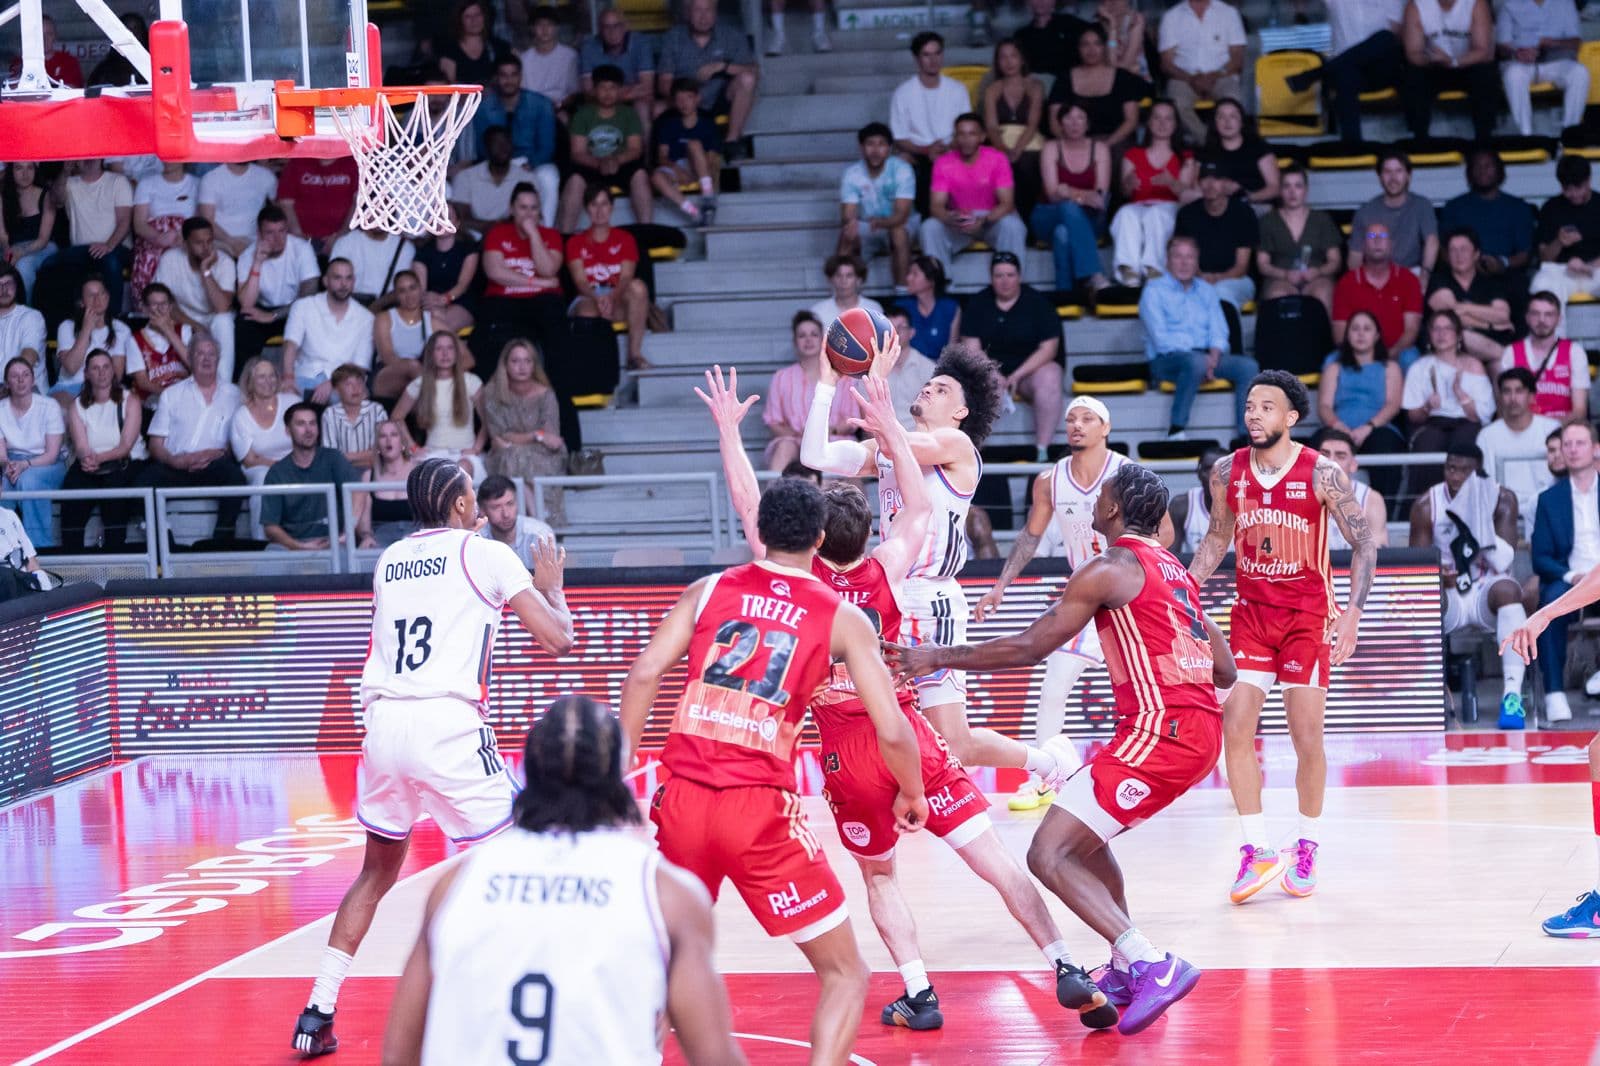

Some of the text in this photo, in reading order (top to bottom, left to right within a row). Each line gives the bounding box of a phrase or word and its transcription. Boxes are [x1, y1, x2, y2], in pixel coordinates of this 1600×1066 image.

[1261, 536, 1273, 554] 4
[385, 556, 447, 583] DOKOSSI
[1241, 556, 1300, 576] Stradim
[741, 594, 807, 630] TREFLE
[394, 616, 433, 675] 13
[703, 619, 799, 708] 21
[688, 703, 760, 732] E.Leclerc
[928, 785, 955, 816] RH
[1123, 783, 1145, 797] TOP
[846, 826, 865, 836] TOP
[485, 874, 612, 907] STEVENS
[768, 881, 801, 915] RH
[507, 972, 554, 1066] 9
